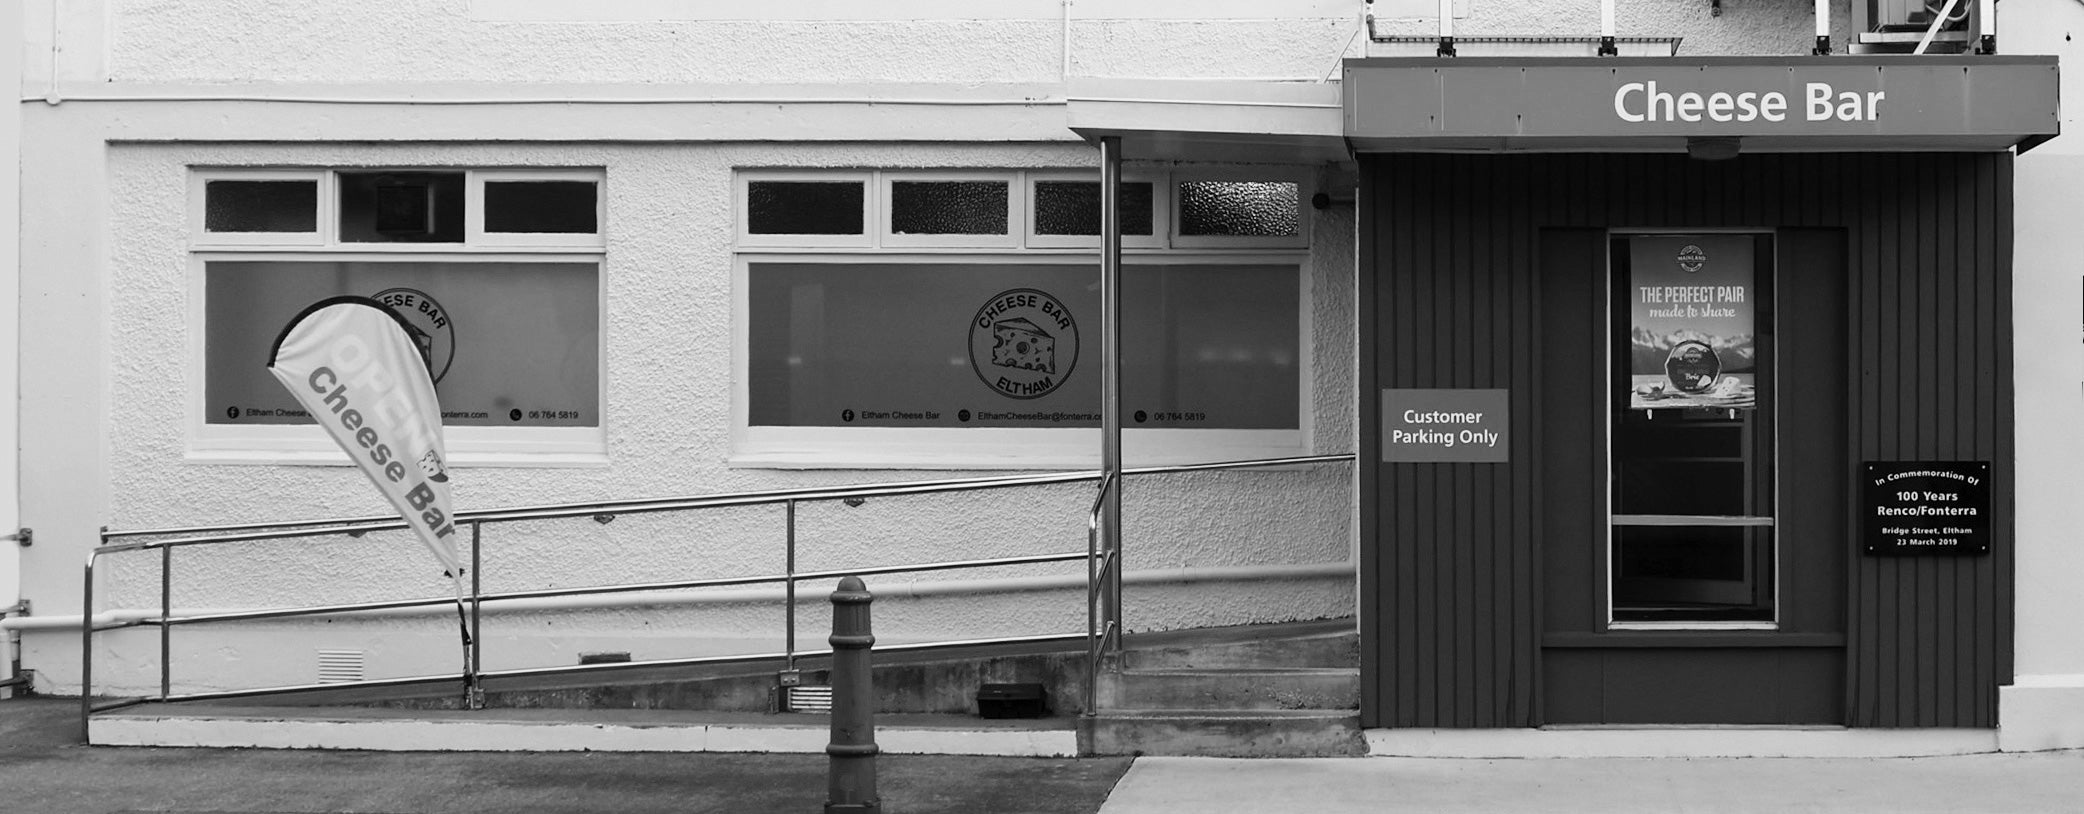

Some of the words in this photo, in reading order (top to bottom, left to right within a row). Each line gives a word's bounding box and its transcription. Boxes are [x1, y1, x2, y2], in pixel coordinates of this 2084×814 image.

[1614, 80, 1787, 122] Cheese
[1806, 82, 1885, 121] Bar
[1640, 286, 1662, 303] THE
[1665, 286, 1715, 303] PERFECT
[1718, 286, 1744, 303] PAIR
[418, 301, 446, 329] BAR
[979, 295, 1037, 329] CHEESE
[1042, 301, 1070, 330] BAR
[1649, 304, 1685, 318] made
[1686, 304, 1698, 318] to
[1701, 303, 1736, 318] share
[331, 333, 438, 440] OPEN
[996, 376, 1053, 395] ELTHAM
[246, 409, 273, 417] Eltham
[276, 409, 306, 417] Cheese
[529, 411, 540, 419] 06
[541, 411, 556, 419] 764
[558, 411, 579, 419] 5819
[862, 411, 890, 420] Eltham
[892, 411, 924, 420] Cheese
[925, 411, 941, 420] Bar
[1154, 412, 1165, 421] 06
[1166, 412, 1182, 421] 764
[1184, 412, 1206, 421] 5819
[1404, 409, 1483, 423] Customer
[1393, 428, 1454, 447] Parking
[1459, 429, 1498, 447] Only
[309, 366, 406, 483] Cheese
[405, 482, 455, 539] Bar
[1875, 478, 1886, 486] In
[1887, 470, 1965, 482] Commemoration
[1967, 476, 1980, 486] Of
[1896, 491, 1919, 501] 100
[1923, 491, 1958, 501] Years
[1877, 505, 1977, 516] Renco/Fonterra
[1882, 527, 1909, 536] Bridge
[1897, 538, 1907, 546] 23
[1910, 538, 1936, 546] March
[1938, 538, 1958, 546] 2019
